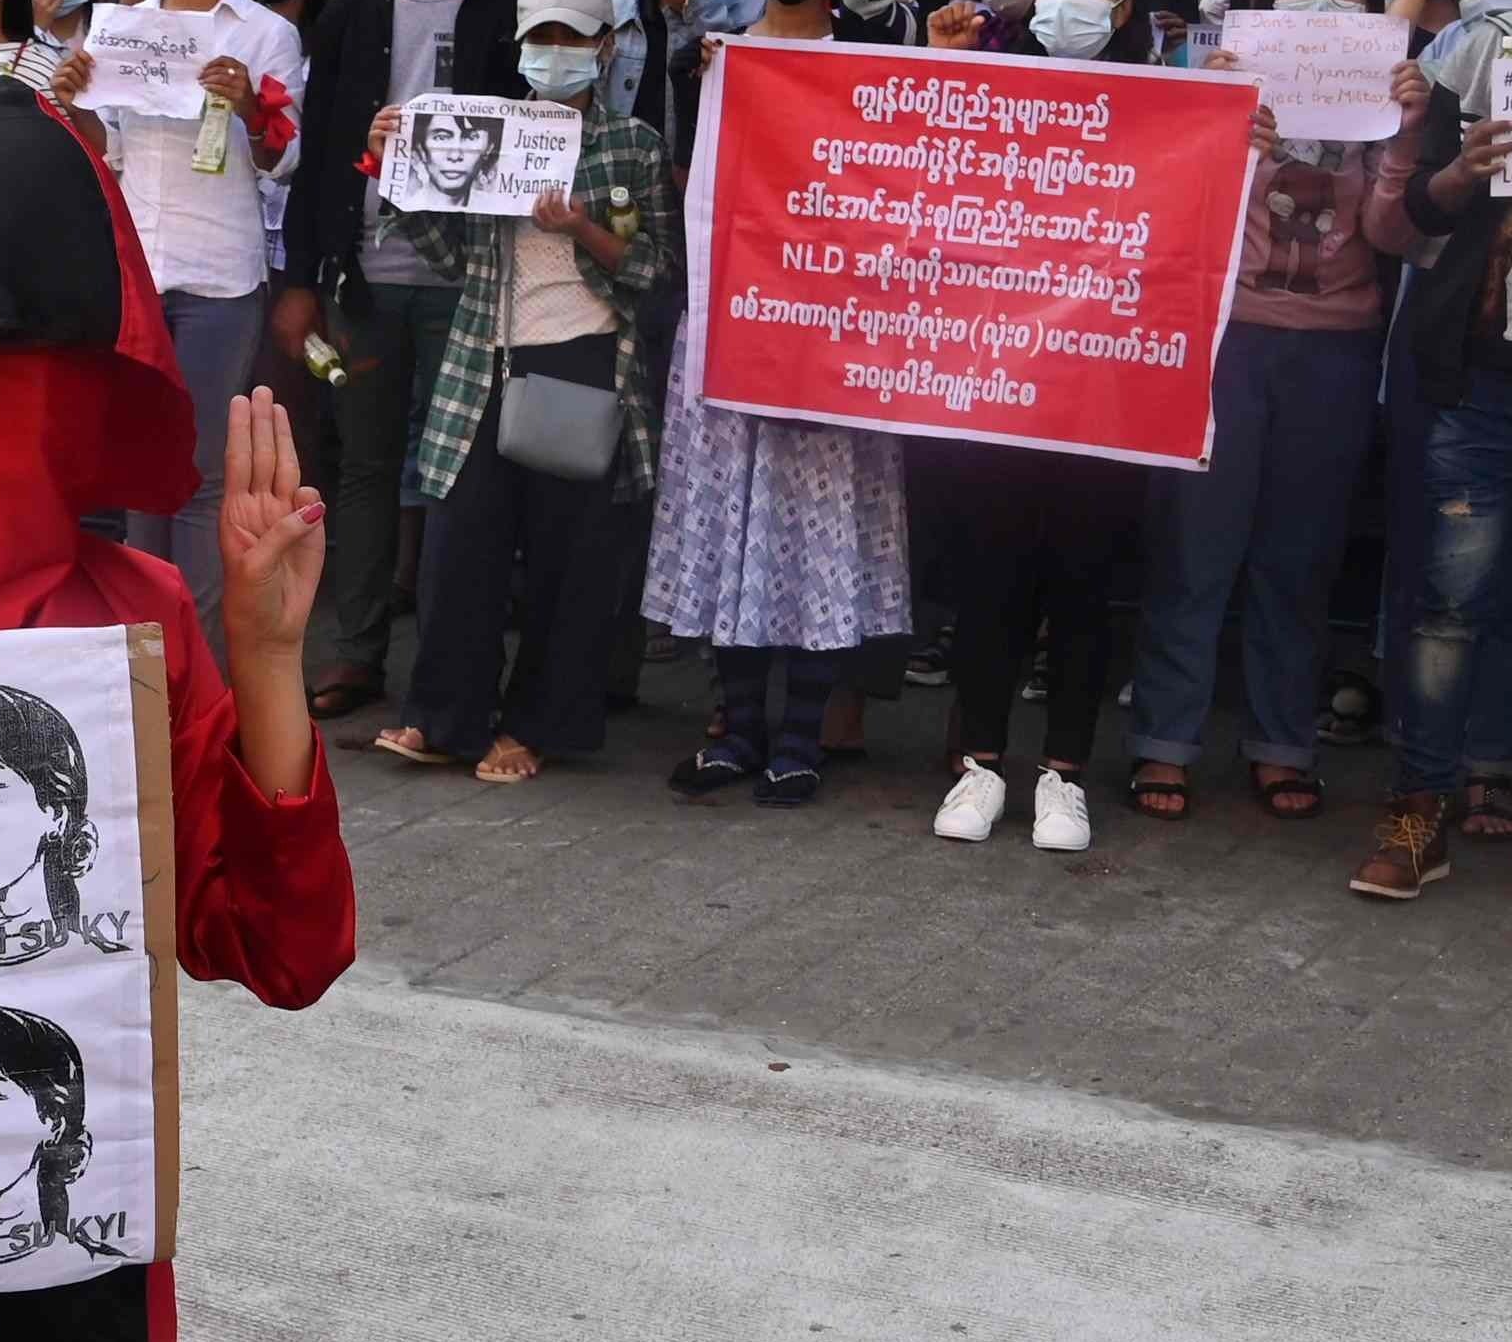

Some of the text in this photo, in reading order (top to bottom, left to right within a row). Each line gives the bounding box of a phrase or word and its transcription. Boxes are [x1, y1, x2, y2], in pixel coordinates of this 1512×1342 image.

[1307, 14, 1339, 28] need
[1194, 32, 1221, 47] FREE
[1253, 40, 1327, 57] just need
[432, 100, 578, 120] The Voice Of Myanmar
[513, 128, 568, 152] Justice
[523, 152, 551, 172] For
[498, 172, 569, 197] Myanmar
[782, 241, 844, 274] NLD
[22, 918, 70, 950] SU
[10, 1220, 55, 1254] SU
[68, 1211, 128, 1245] KYI
